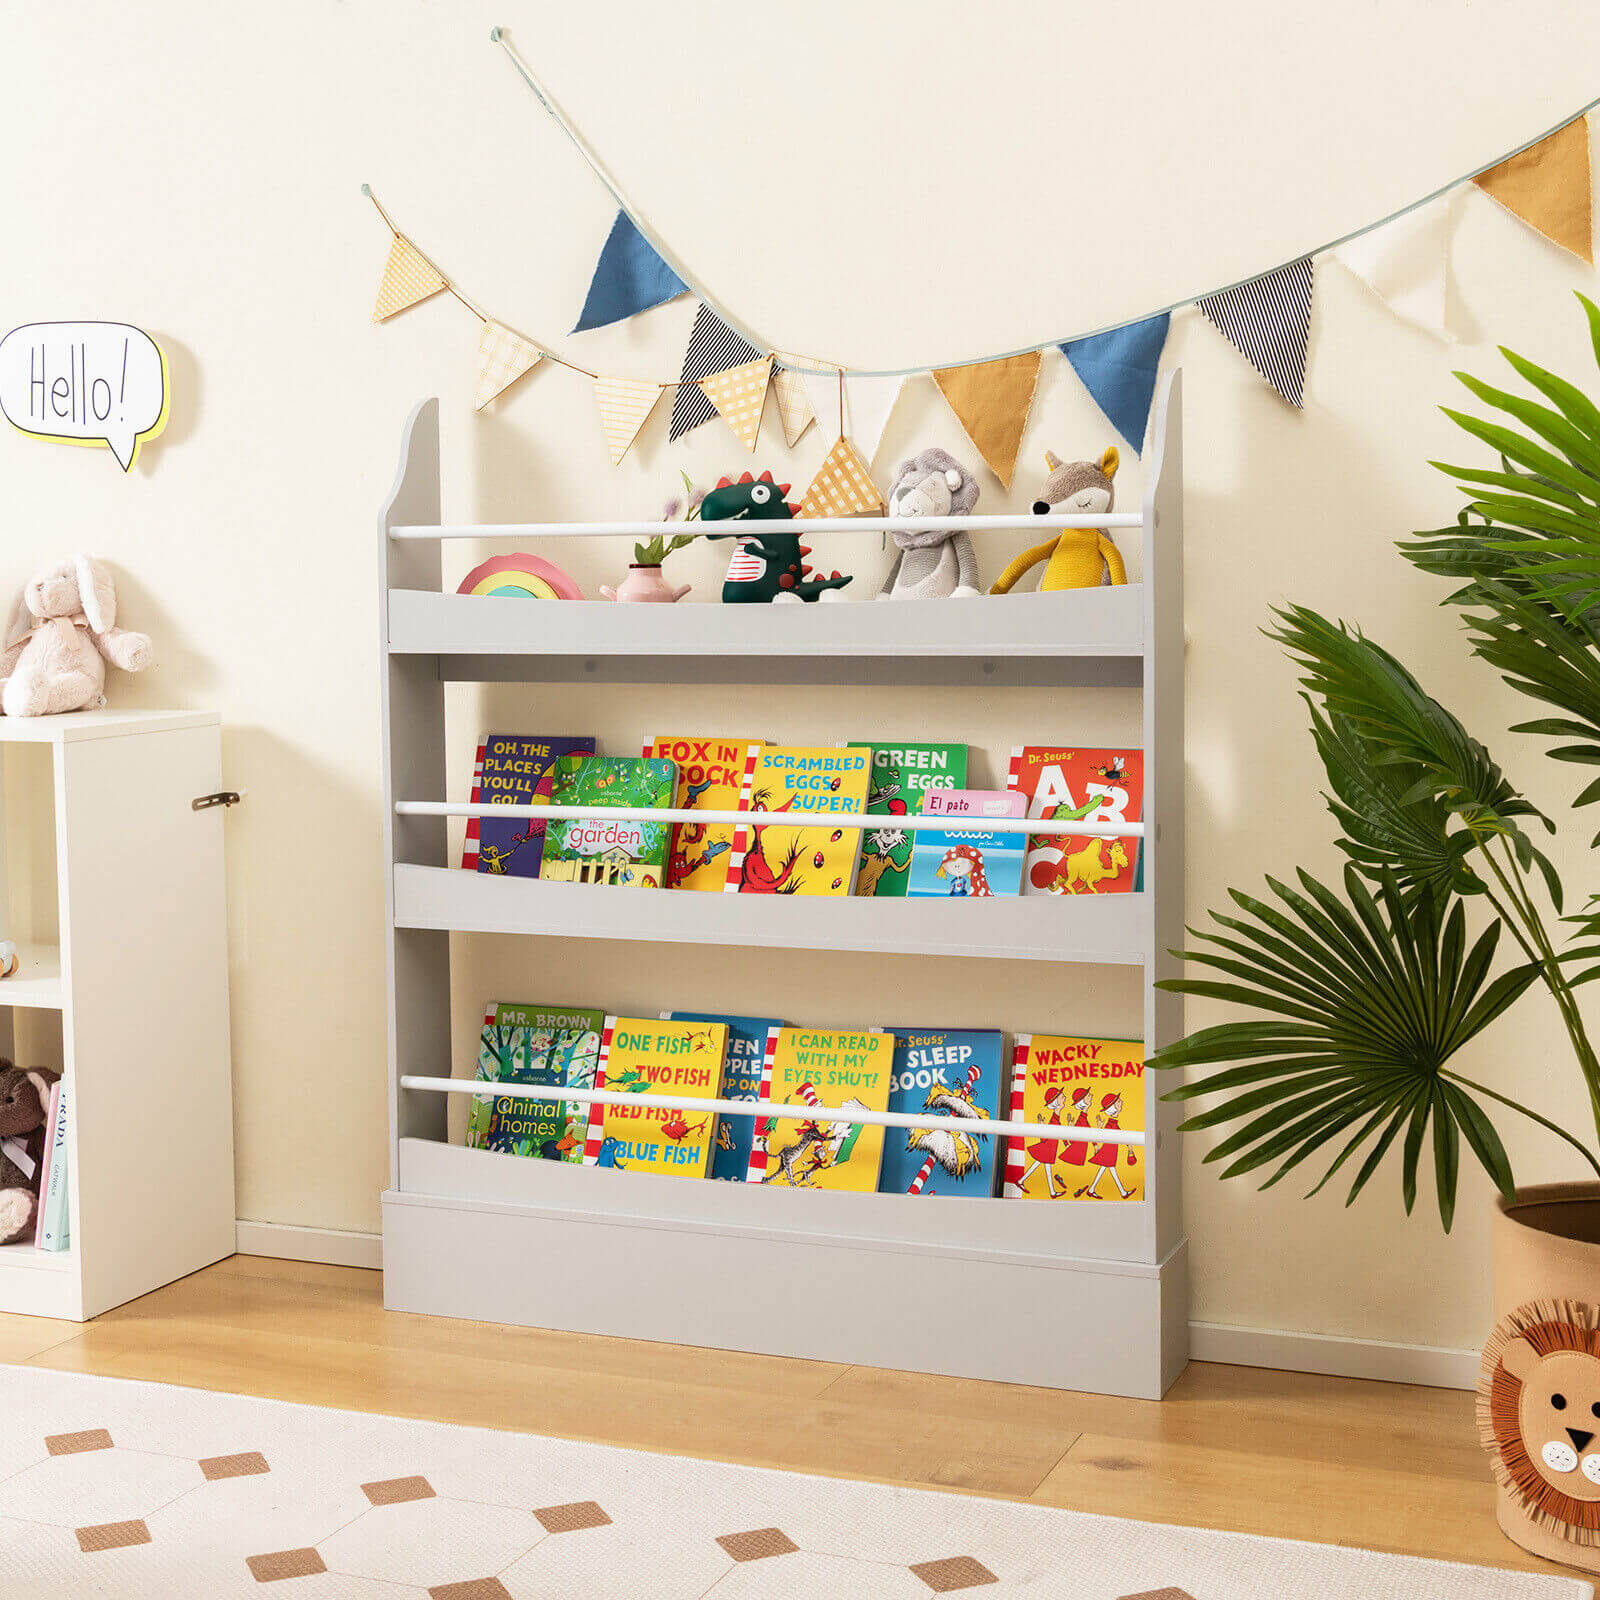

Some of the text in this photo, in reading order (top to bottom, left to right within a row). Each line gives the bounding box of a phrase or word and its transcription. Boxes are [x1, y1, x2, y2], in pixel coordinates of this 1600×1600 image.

[31, 338, 128, 425] Hello!
[493, 741, 551, 758] OH, THE
[658, 741, 738, 762] FOX IN
[1028, 753, 1042, 764] Dr.
[485, 758, 542, 775] PLACES
[763, 755, 865, 772] SCRAMBLED
[874, 750, 948, 769] GREEN
[482, 776, 532, 793] YOU'LL
[784, 774, 832, 791] EGGS
[907, 773, 955, 791] EGGS
[792, 795, 861, 814] SUPER!
[930, 796, 942, 810] El
[946, 798, 970, 813] pato
[589, 820, 605, 830] the
[569, 823, 641, 849] garden
[502, 1011, 591, 1030] MR. BROWN
[617, 1032, 692, 1055] ONE FISH
[791, 1034, 879, 1052] I CAN READ
[796, 1052, 869, 1068] WITH MY
[906, 1045, 973, 1069] SLEEP
[1035, 1044, 1103, 1066] WACKY
[635, 1065, 711, 1087] TWO FISH
[784, 1068, 880, 1089] EYES SHUT!
[1031, 1062, 1144, 1087] WEDNESDAY
[739, 1079, 760, 1092] ON
[609, 1104, 683, 1122] RED FISH
[500, 1115, 556, 1136] homes
[616, 1140, 701, 1165] BLUE FISH
